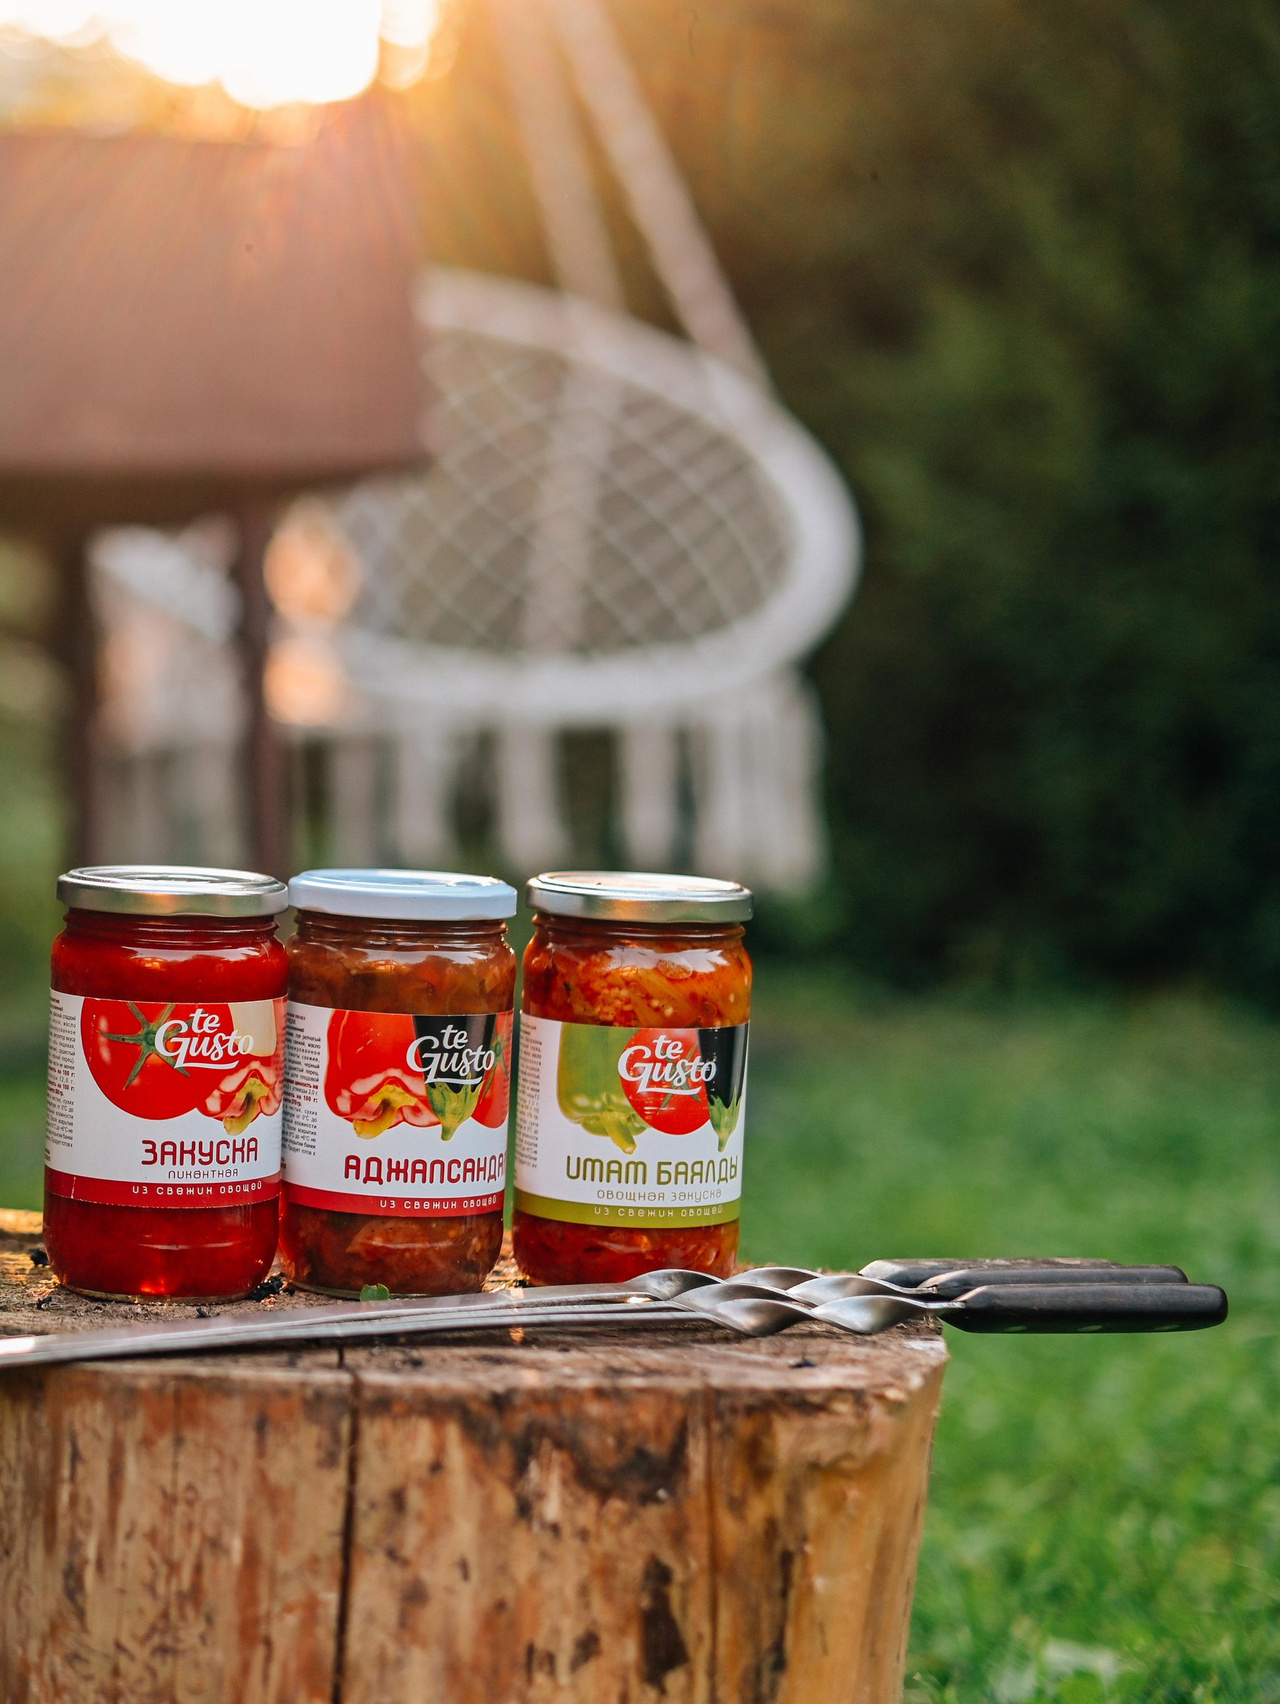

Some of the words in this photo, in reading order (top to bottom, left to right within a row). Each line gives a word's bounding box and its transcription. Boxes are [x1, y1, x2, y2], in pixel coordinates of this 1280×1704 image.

[190, 1008, 221, 1033] te
[154, 1020, 254, 1070] Gusto
[440, 1024, 468, 1050] te
[652, 1034, 684, 1060] te
[406, 1036, 495, 1085] Gusto
[617, 1045, 716, 1095] Gusto
[140, 1136, 259, 1167] ЗАКУСКА
[344, 1151, 506, 1186] АДЖАПСАНДА
[566, 1155, 648, 1186] ИМАМ
[656, 1155, 738, 1186] БАЯЛДЫ
[132, 1186, 149, 1195] из
[220, 1180, 262, 1194] овощей
[596, 1189, 666, 1202] овощная
[670, 1188, 722, 1203] закуска
[380, 1200, 396, 1209] из
[594, 1206, 610, 1215] из
